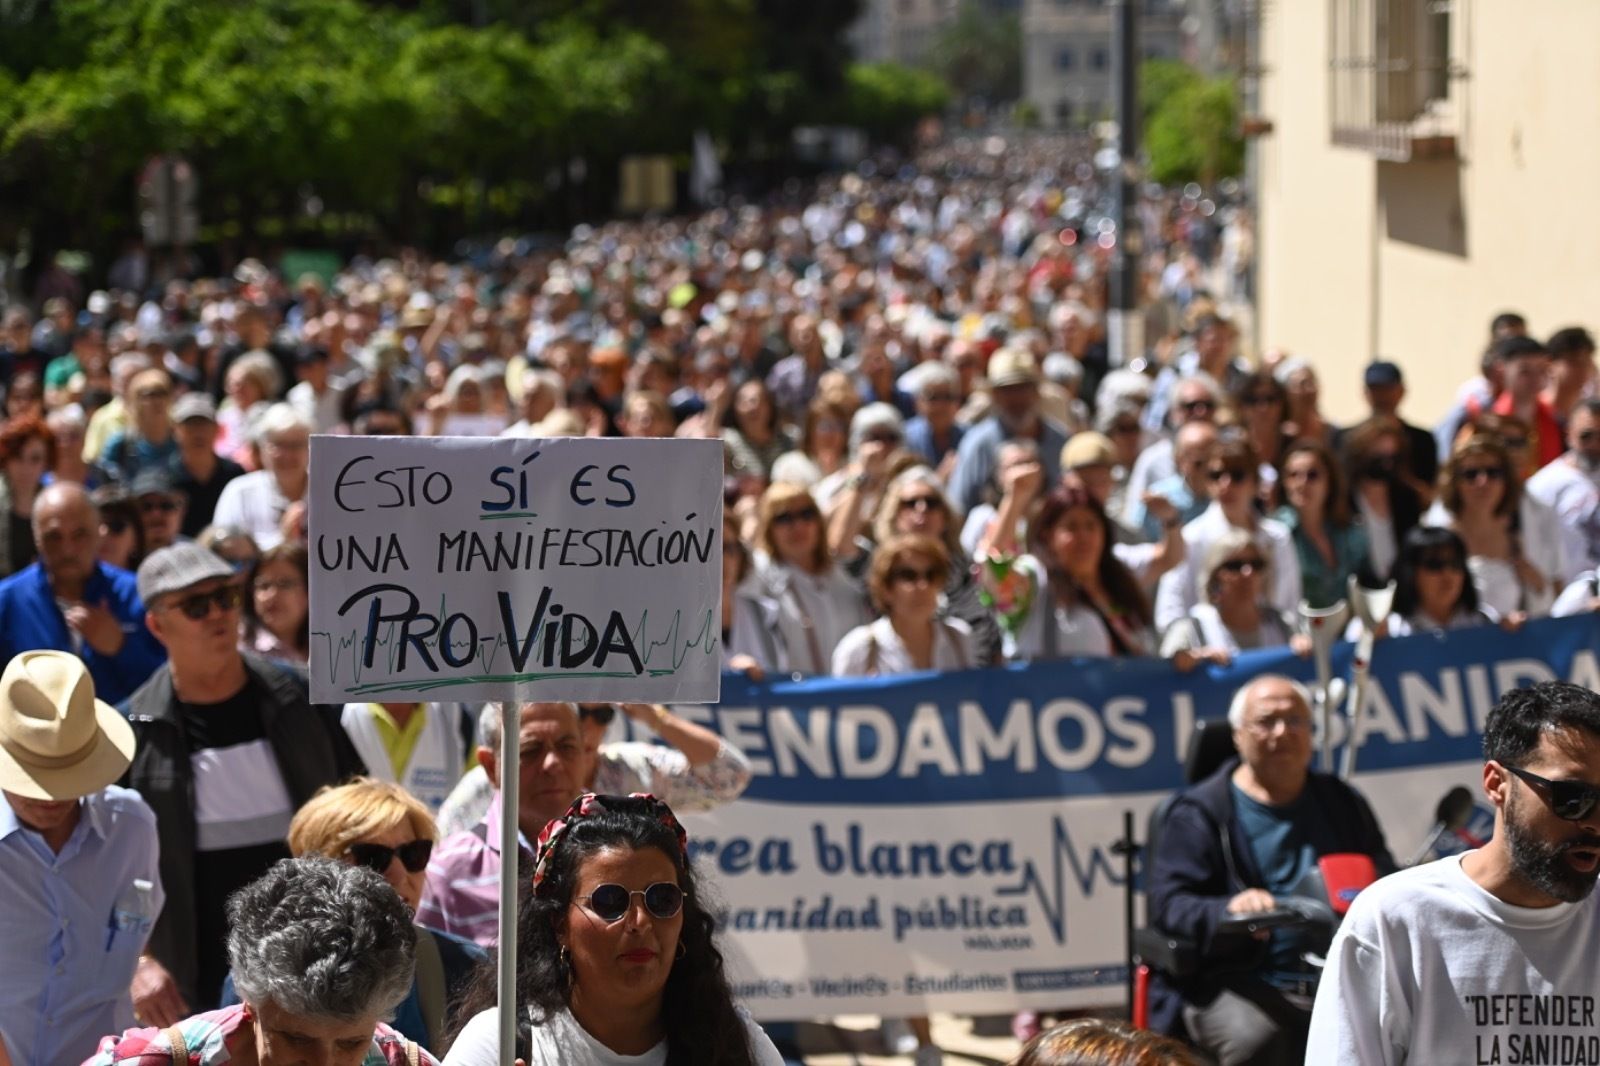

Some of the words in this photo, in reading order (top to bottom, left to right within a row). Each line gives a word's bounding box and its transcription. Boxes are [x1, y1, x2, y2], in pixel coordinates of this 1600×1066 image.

[334, 455, 453, 512] ESTO
[481, 451, 541, 511] SÍ
[570, 464, 637, 507] ES
[318, 533, 410, 573] UNA
[602, 697, 1155, 779] ENDAMOS
[688, 838, 798, 875] rea
[812, 822, 1016, 876] blanca
[894, 894, 1027, 941] pública
[1476, 1034, 1501, 1066] LA
[1508, 1033, 1600, 1066] SANIDAD
